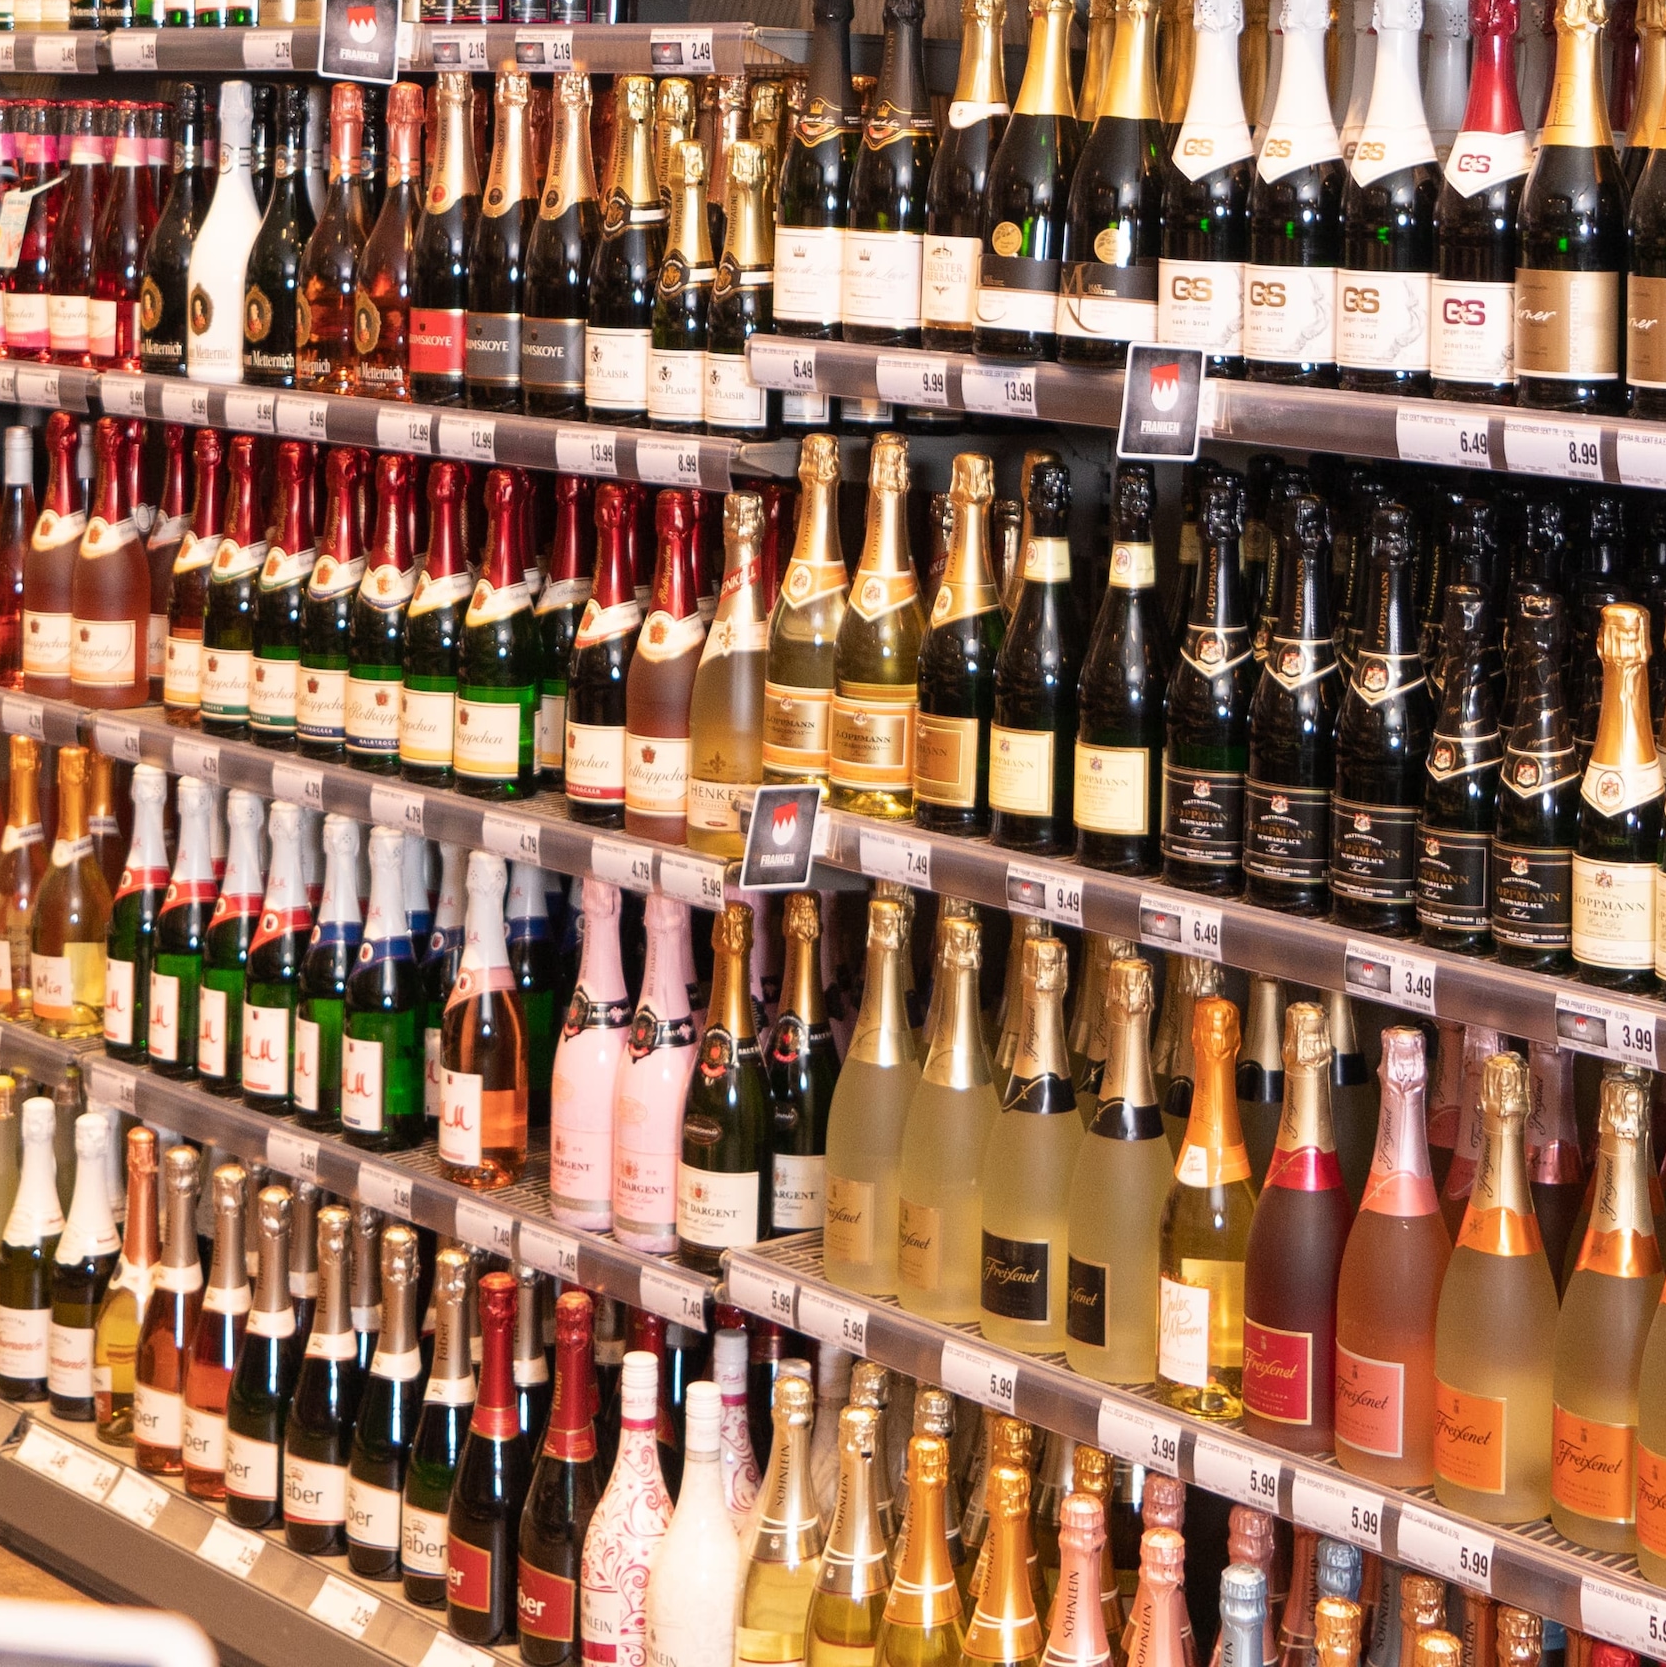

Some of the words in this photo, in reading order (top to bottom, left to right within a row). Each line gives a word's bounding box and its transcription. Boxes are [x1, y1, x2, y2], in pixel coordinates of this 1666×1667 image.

[339, 47, 380, 63] FRANKEN
[793, 360, 813, 378] 6.49
[923, 372, 944, 393] 9.99
[1004, 381, 1032, 402] 13.99
[1140, 420, 1180, 434] FRANKEN
[471, 431, 492, 449] 12.99
[1460, 431, 1488, 454] 6.49
[591, 443, 613, 462] 13.99
[678, 454, 696, 472] 8.99
[1569, 441, 1598, 465] 8.99
[759, 852, 795, 866] FRANKEN
[906, 852, 927, 875] 7.49
[1056, 887, 1080, 910] 9.49
[1194, 921, 1218, 945] 6.49
[1405, 972, 1432, 998] 3.49
[1623, 1024, 1653, 1052] 3.99
[983, 1257, 1040, 1289] Freixenet
[1244, 1347, 1297, 1380] Freixenet
[1436, 1410, 1492, 1446] Freixenet
[1556, 1439, 1623, 1475] Freixenet
[1250, 1469, 1275, 1497] 5.99
[1352, 1506, 1378, 1535] 5.99
